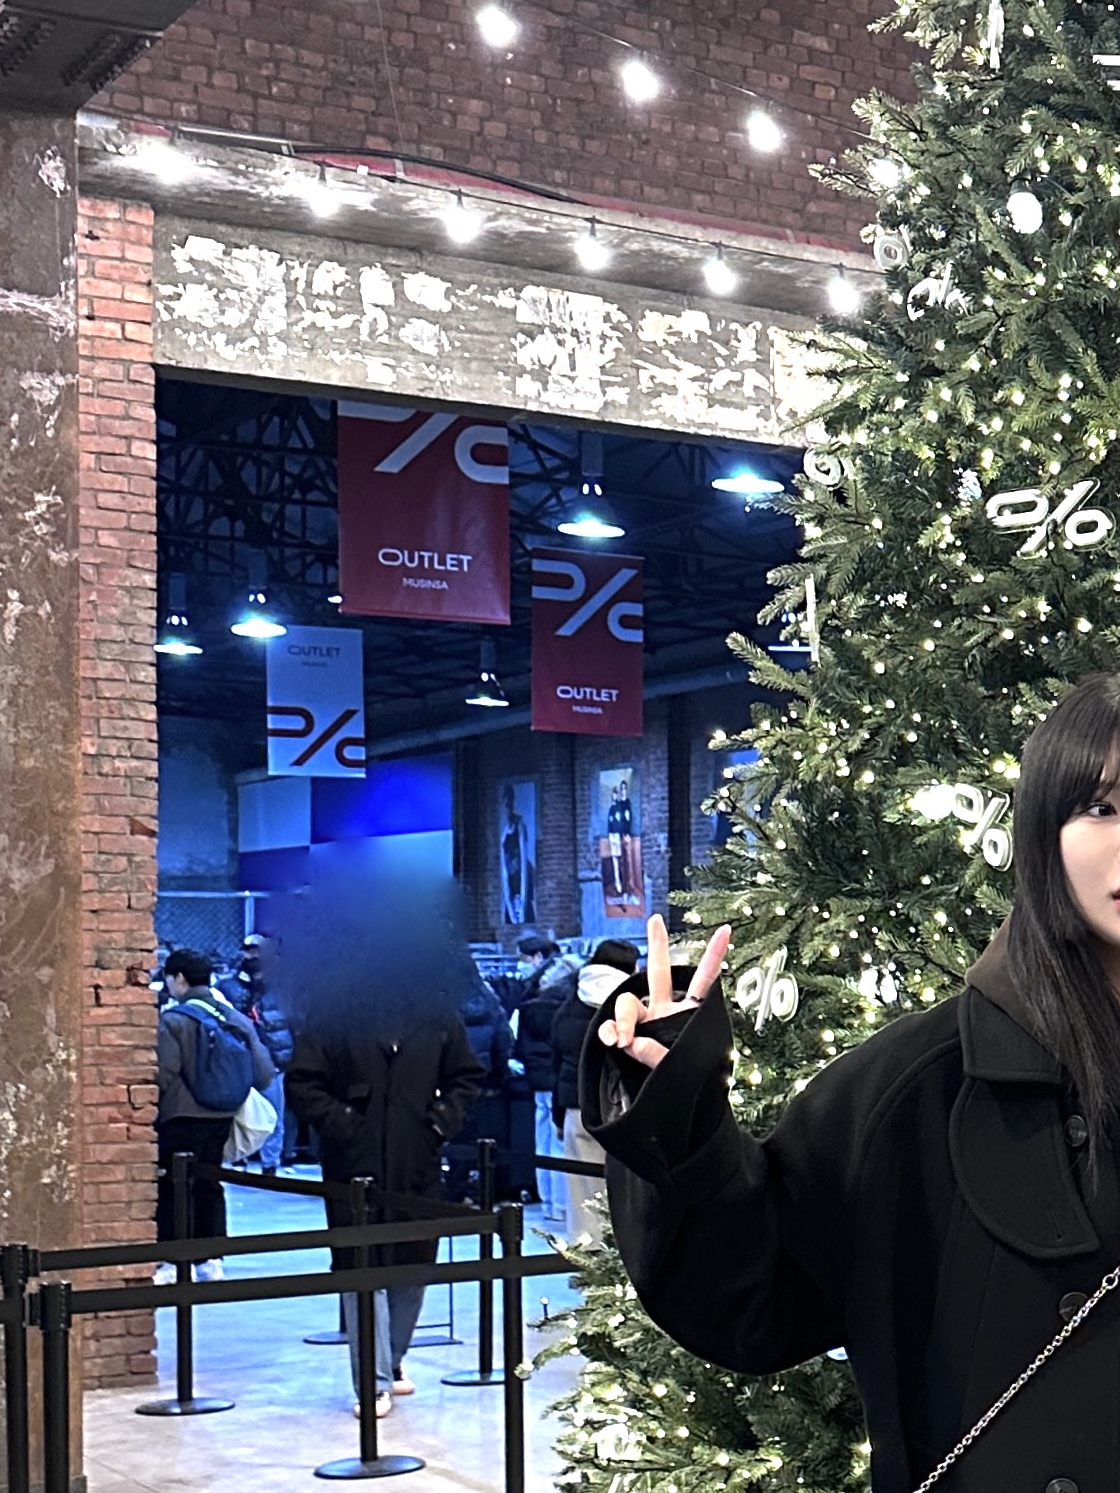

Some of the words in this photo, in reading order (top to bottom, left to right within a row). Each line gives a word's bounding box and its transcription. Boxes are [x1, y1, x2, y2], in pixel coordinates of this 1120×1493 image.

[378, 548, 472, 572] OUTLET
[402, 577, 449, 590] MUSINSA
[288, 645, 341, 657] OUTLET
[556, 686, 619, 702] OUTLET
